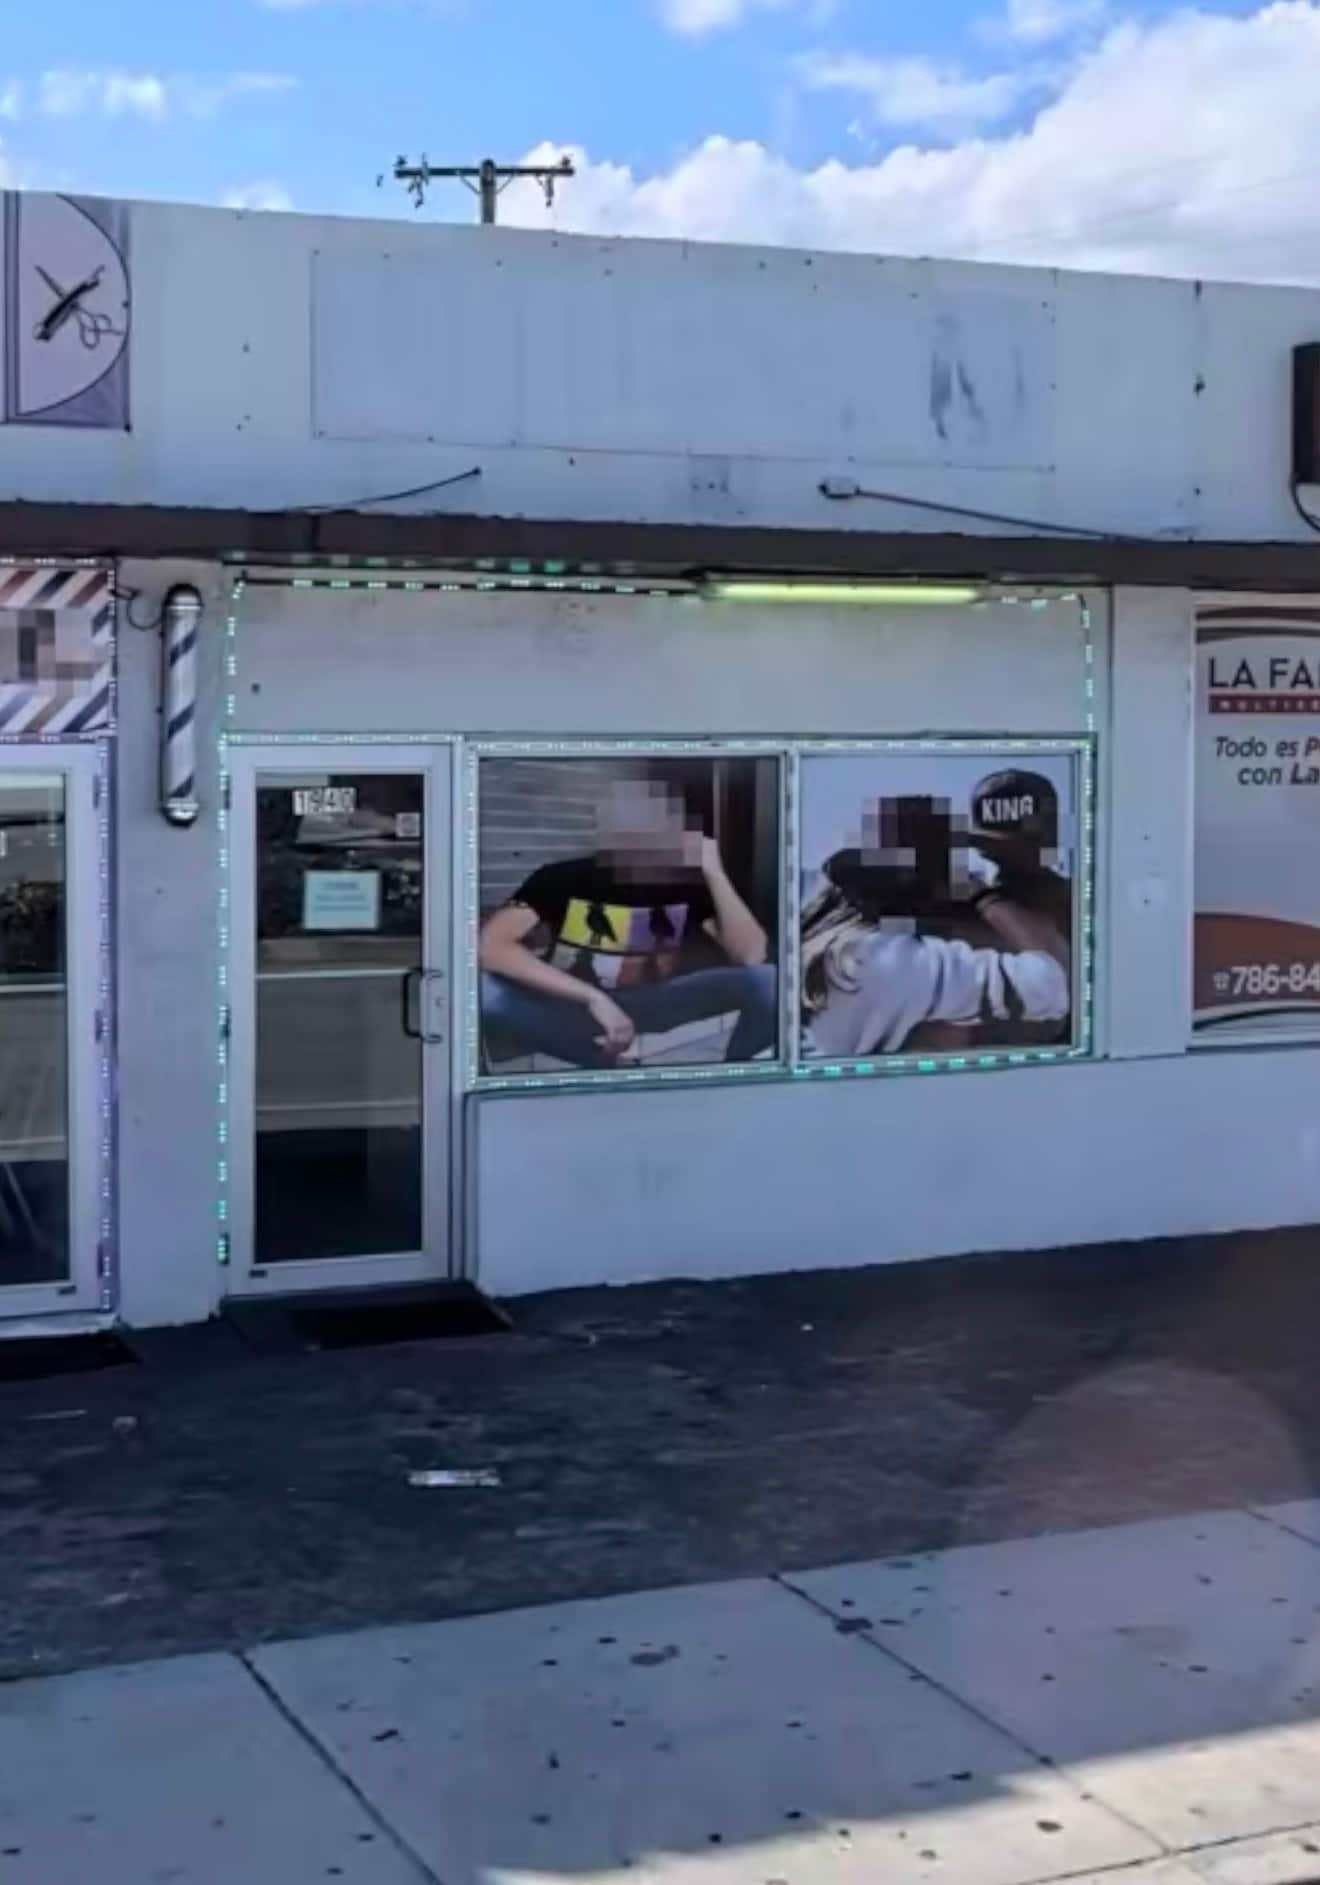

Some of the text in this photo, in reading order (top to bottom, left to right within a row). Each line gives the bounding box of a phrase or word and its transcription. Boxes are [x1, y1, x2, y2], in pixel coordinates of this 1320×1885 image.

[1208, 656, 1320, 689] LA FA
[1215, 735, 1267, 758] Todo
[1275, 739, 1299, 758] es
[1237, 762, 1320, 786] con La
[1231, 963, 1320, 995] 786-84
